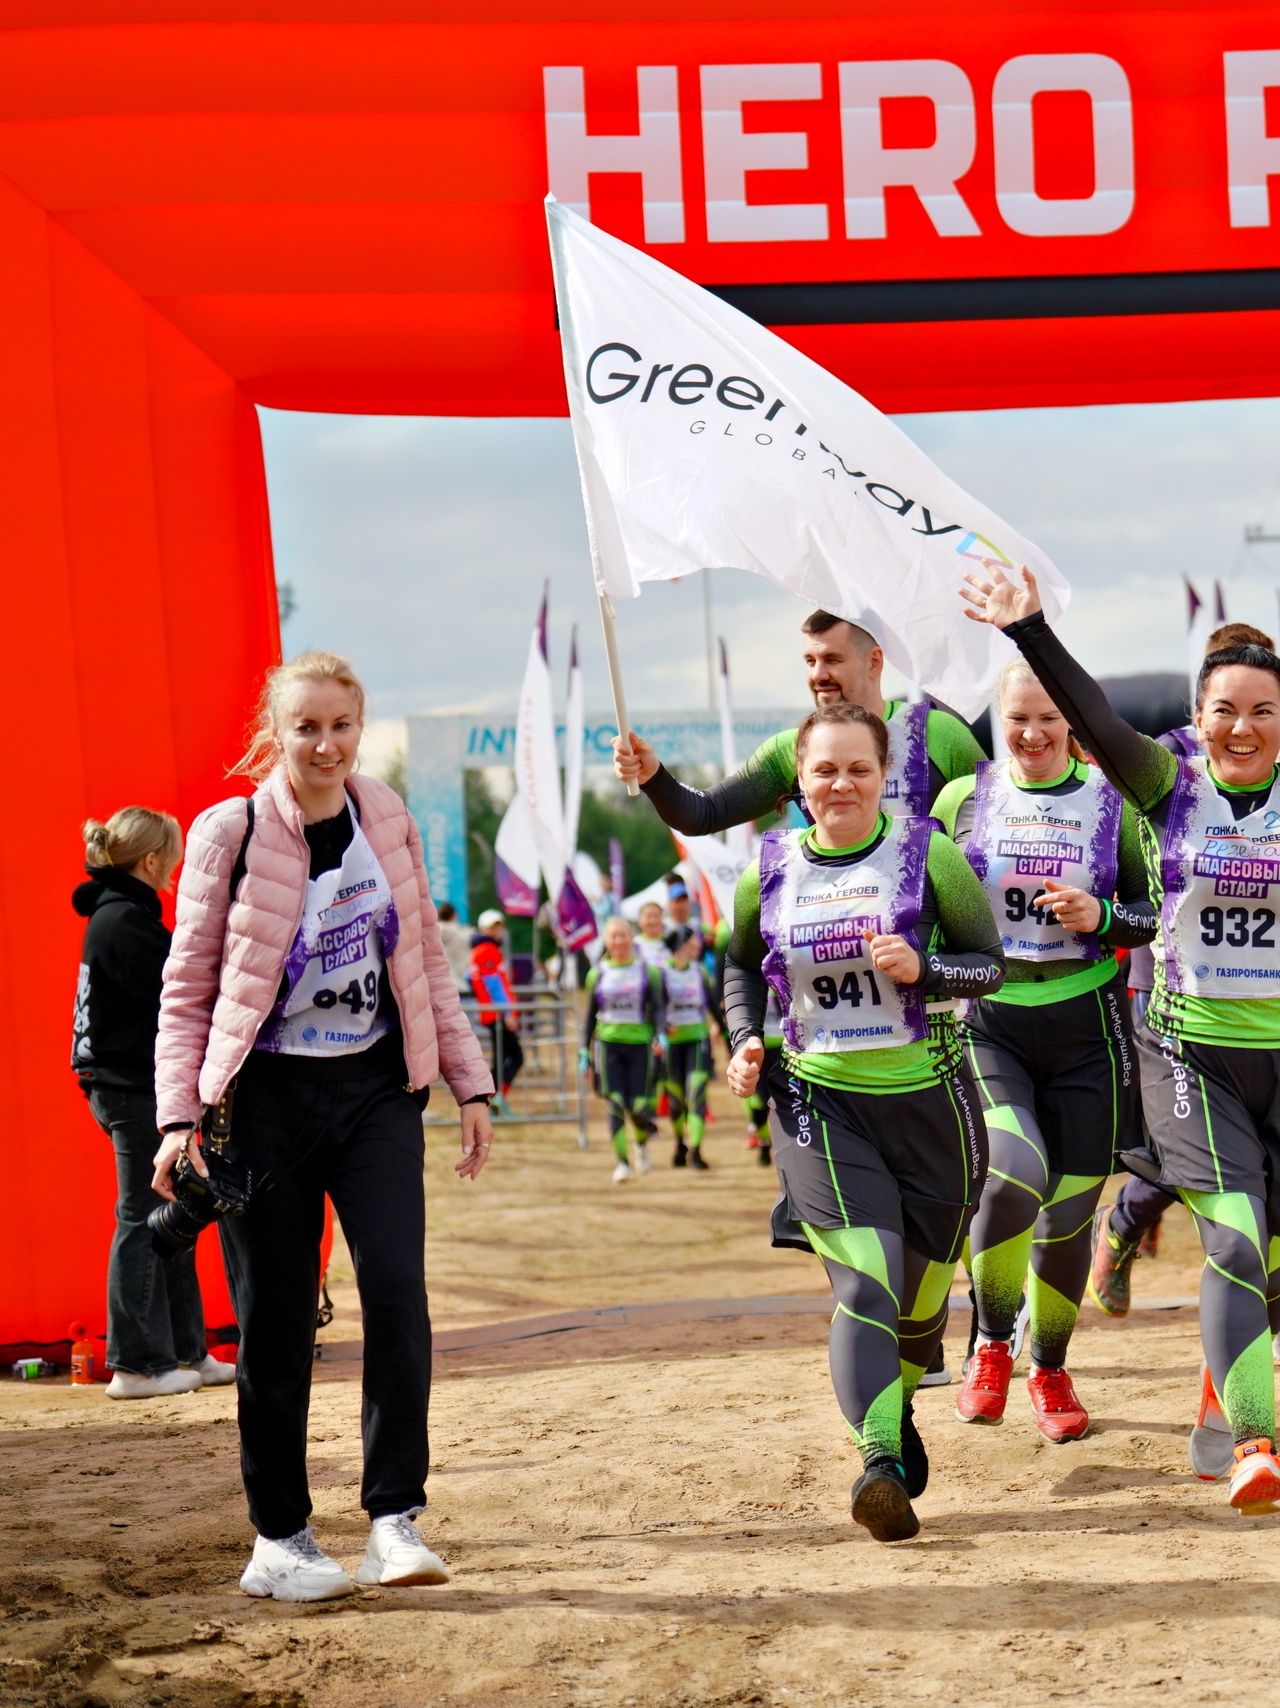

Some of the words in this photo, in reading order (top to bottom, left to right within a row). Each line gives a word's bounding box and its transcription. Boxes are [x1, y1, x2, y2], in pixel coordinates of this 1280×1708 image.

[543, 53, 1135, 244] HERO
[689, 420, 861, 499] GLOBA
[1004, 814, 1038, 824] ГОНКА
[1041, 815, 1082, 828] ГЕРОЕВ
[1205, 825, 1238, 836] ГОНКА
[1263, 810, 1280, 830] 2
[1000, 842, 1080, 861] МАССОВЫЙ
[1018, 858, 1060, 875] СТАРТ
[796, 893, 832, 905] ГОНКА
[836, 886, 879, 897] ГЕРОЕВ
[1217, 880, 1265, 898] СТАРТ
[313, 916, 370, 954] АССОВЫ
[793, 915, 879, 945] МАССОВЫЙ
[1200, 907, 1275, 948] 932
[324, 940, 364, 971] СТАРТ
[815, 940, 859, 962] СТАРТ
[1018, 939, 1065, 952] ГАЗПРОМБАНК
[929, 955, 991, 984] Genway
[812, 969, 882, 1010] 941
[831, 1025, 894, 1039] ГАЗПРОМБАНК
[1158, 1038, 1191, 1119] Greenay
